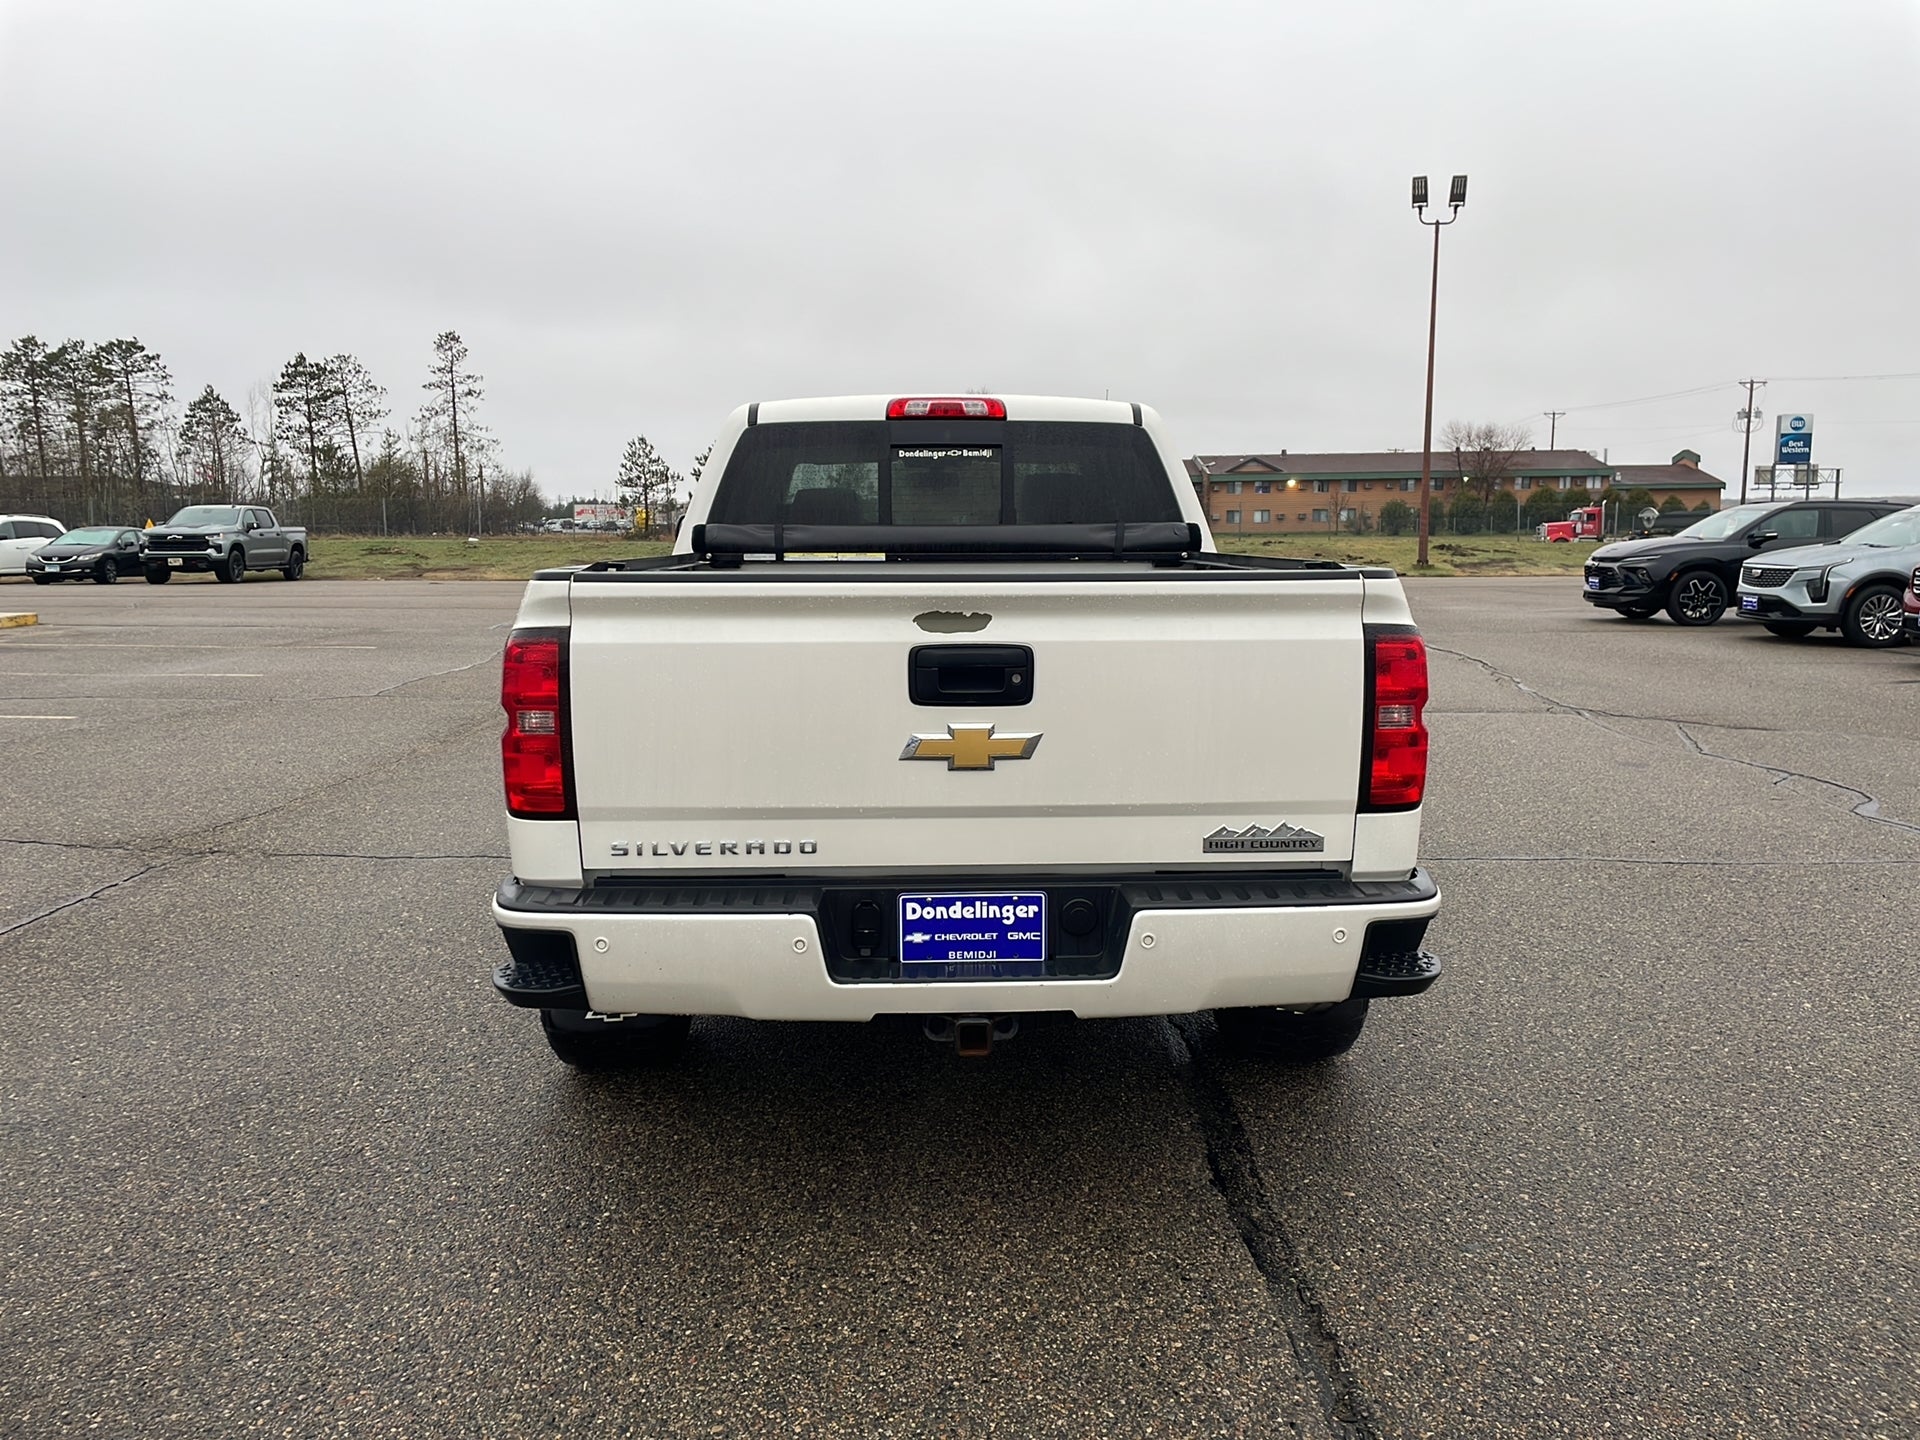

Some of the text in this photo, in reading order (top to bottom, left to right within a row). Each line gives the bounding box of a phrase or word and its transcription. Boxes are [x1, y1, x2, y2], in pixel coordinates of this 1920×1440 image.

[898, 449, 992, 460] Dondelinger Bemidji
[1781, 446, 1810, 454] Western
[610, 839, 818, 857] SILVERADO
[1209, 840, 1319, 849] HIGH COUNTRY
[905, 901, 1039, 925] Dondelinger
[934, 932, 1041, 941] CHEVROLET GMC
[948, 951, 997, 960] BEMIDJI
